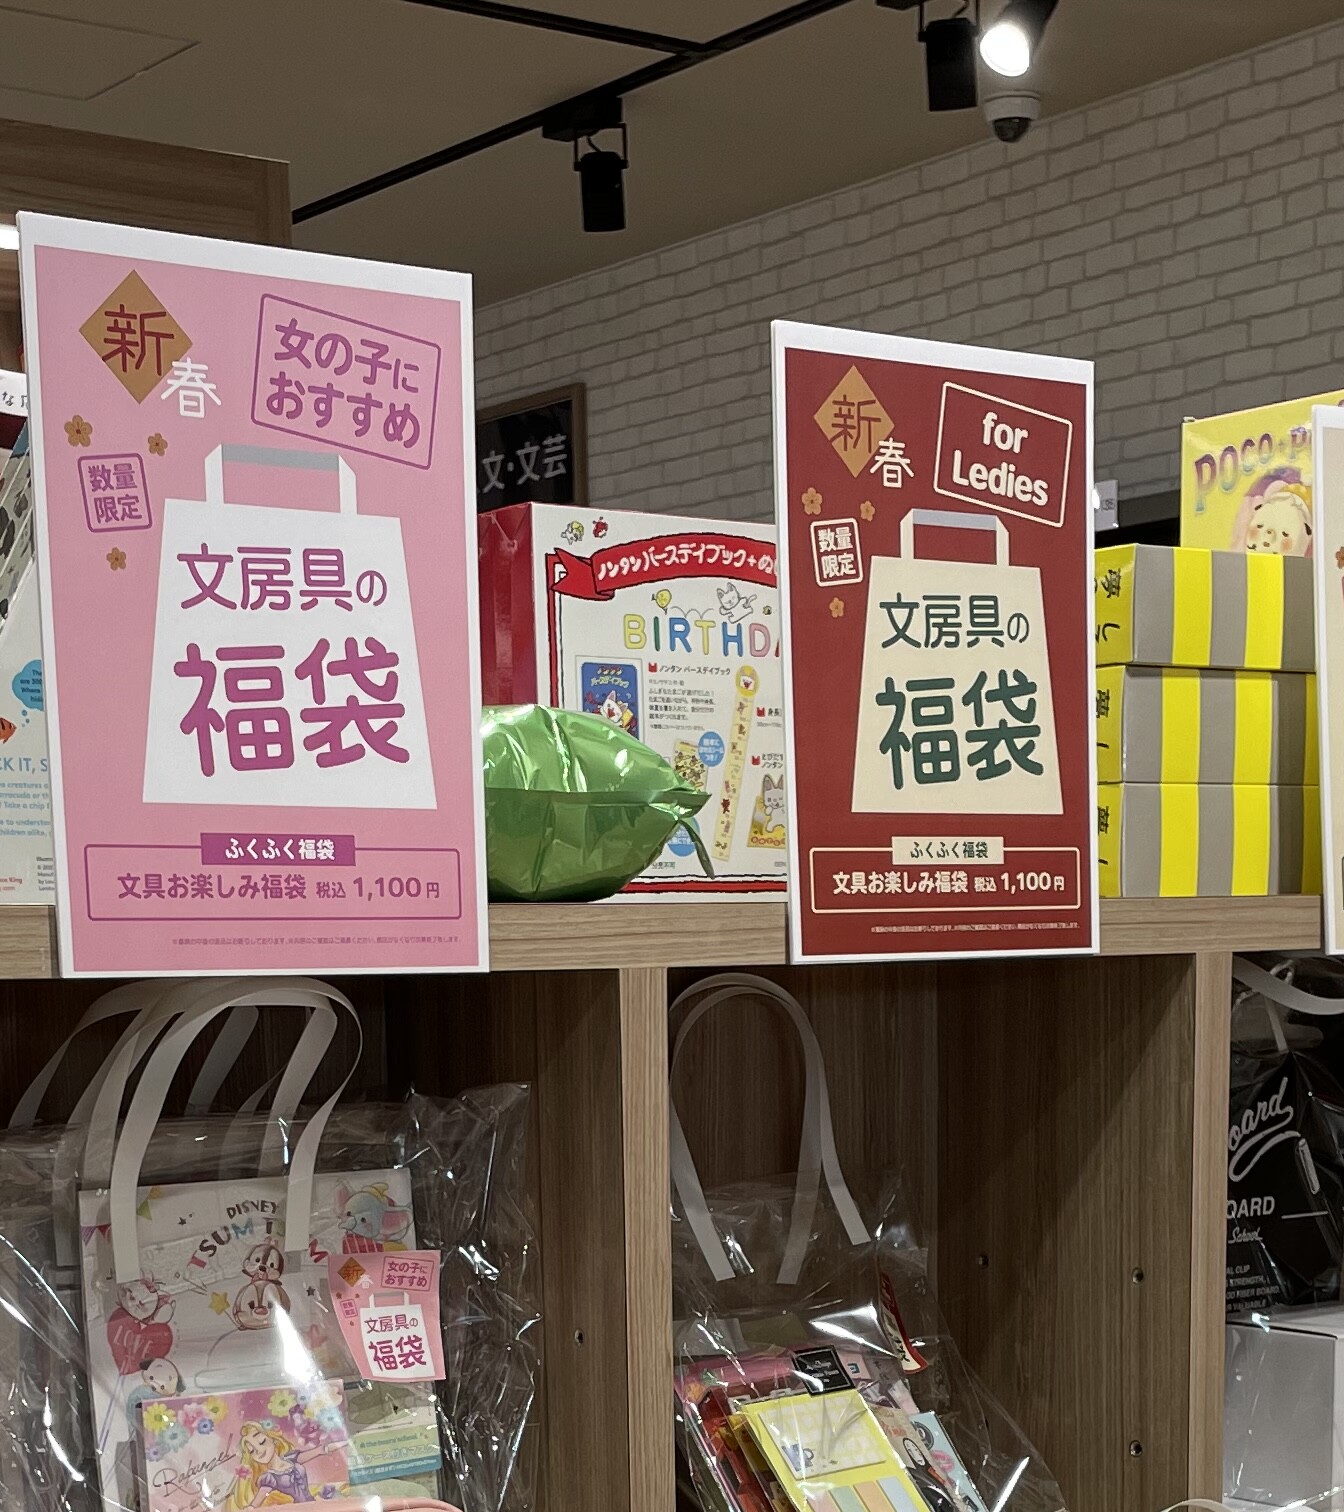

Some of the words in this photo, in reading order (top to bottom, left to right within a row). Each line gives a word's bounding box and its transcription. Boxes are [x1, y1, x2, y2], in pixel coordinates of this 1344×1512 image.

[274, 317, 421, 396] 女の子に
[265, 372, 420, 450] おすすめ
[982, 413, 1028, 451] for
[88, 464, 137, 492] 数量
[954, 450, 1048, 506] Ledies
[95, 496, 143, 523] 限定
[818, 526, 852, 552] 数量
[176, 543, 388, 612] 文房具の
[822, 553, 857, 577] 限定
[879, 591, 1029, 649] 文房具の
[174, 636, 411, 778] 福袋
[876, 669, 1044, 790] 福袋
[19, 757, 35, 774] IT,
[225, 839, 336, 862] ふくふく福袋
[910, 841, 989, 859] ふくふく福袋
[117, 873, 307, 901] 文具お楽しみ福袋
[316, 880, 346, 899] 税込
[833, 872, 968, 895] 文具お楽しみ福袋
[974, 875, 997, 892] 税込
[1228, 1227, 1263, 1244] School
[385, 1272, 428, 1288] おすすめ
[387, 1260, 428, 1275] 女の子に
[364, 1314, 419, 1334] 文房具の
[368, 1335, 427, 1371] 福袋
